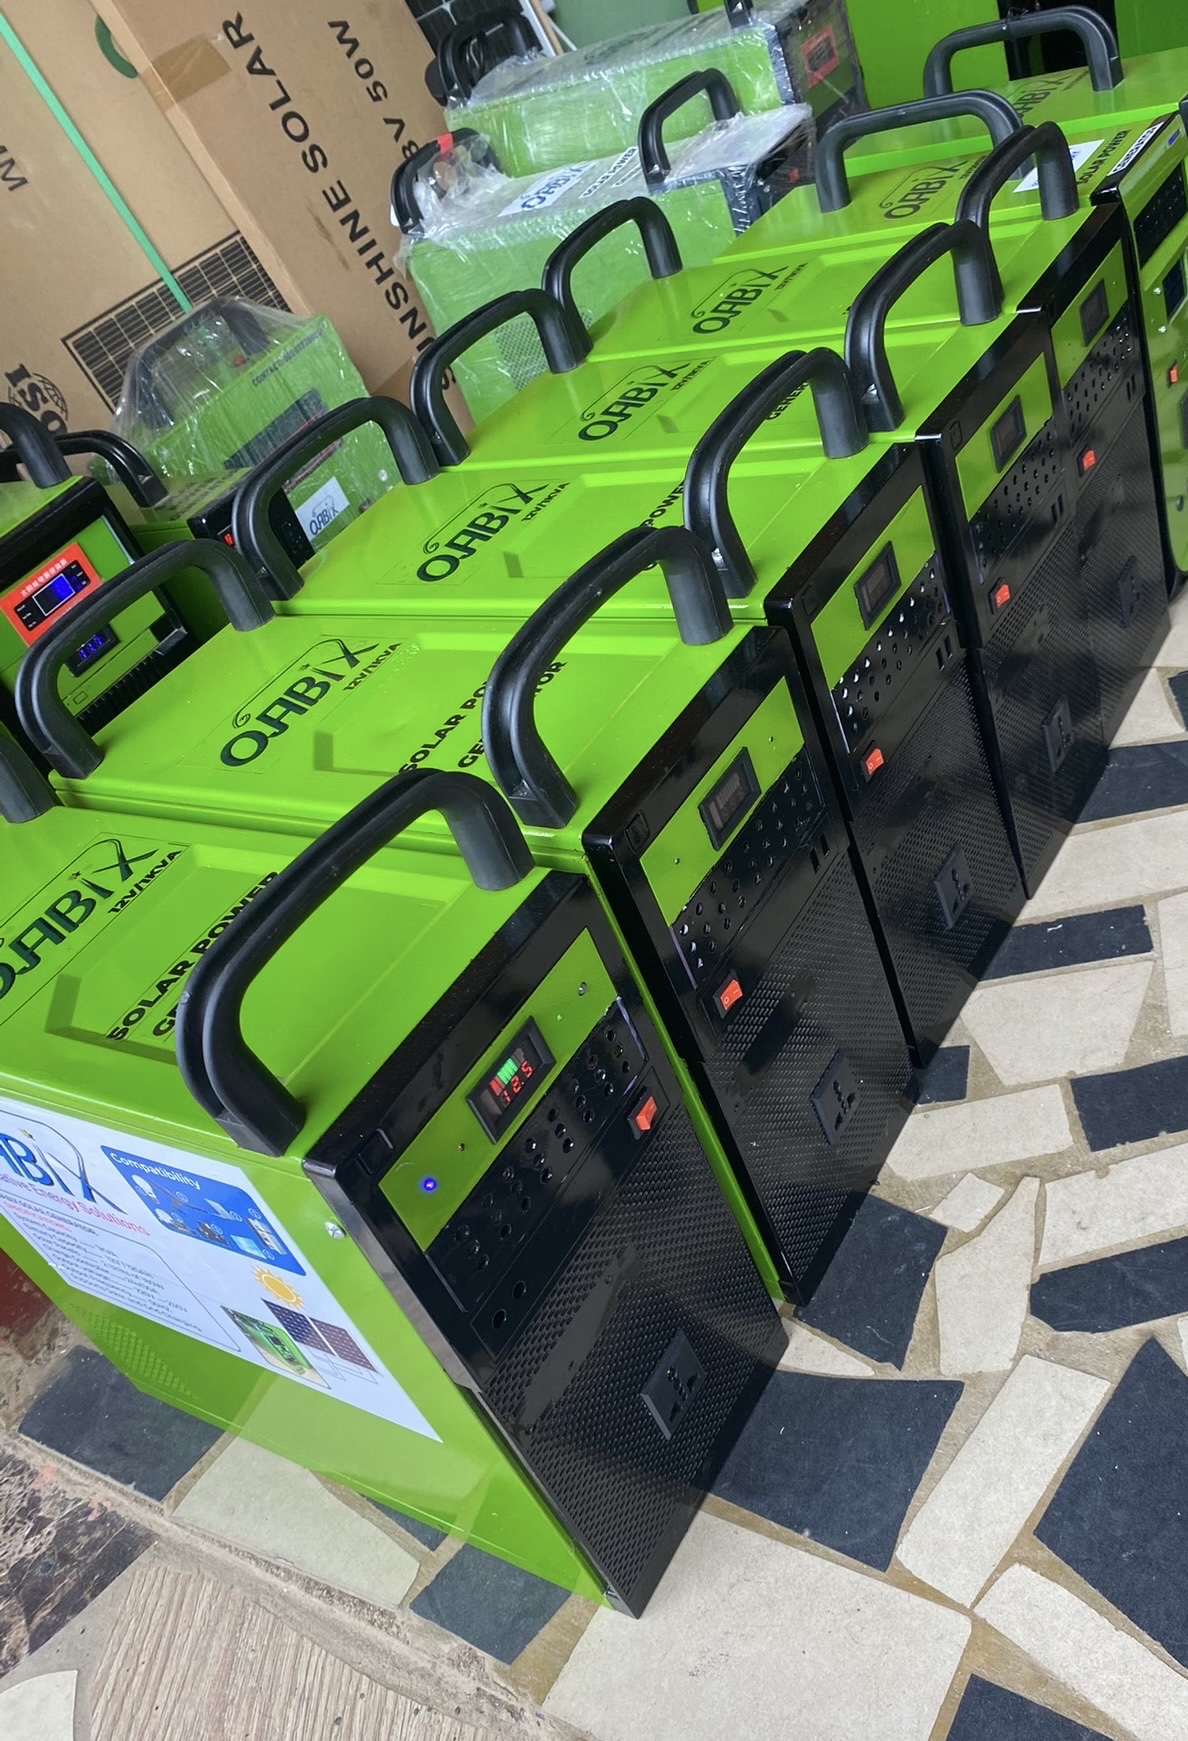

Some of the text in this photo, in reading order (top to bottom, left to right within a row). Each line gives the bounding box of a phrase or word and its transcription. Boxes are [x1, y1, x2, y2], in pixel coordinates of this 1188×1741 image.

[222, 11, 328, 173] SOLAR
[327, 20, 388, 103] 50W
[108, 850, 182, 913] 12V/1KVA
[107, 960, 195, 1041] SOLAR
[110, 1152, 201, 1191] Compatibility
[28, 1183, 79, 1213] Energy
[77, 1202, 150, 1236] Solutions
